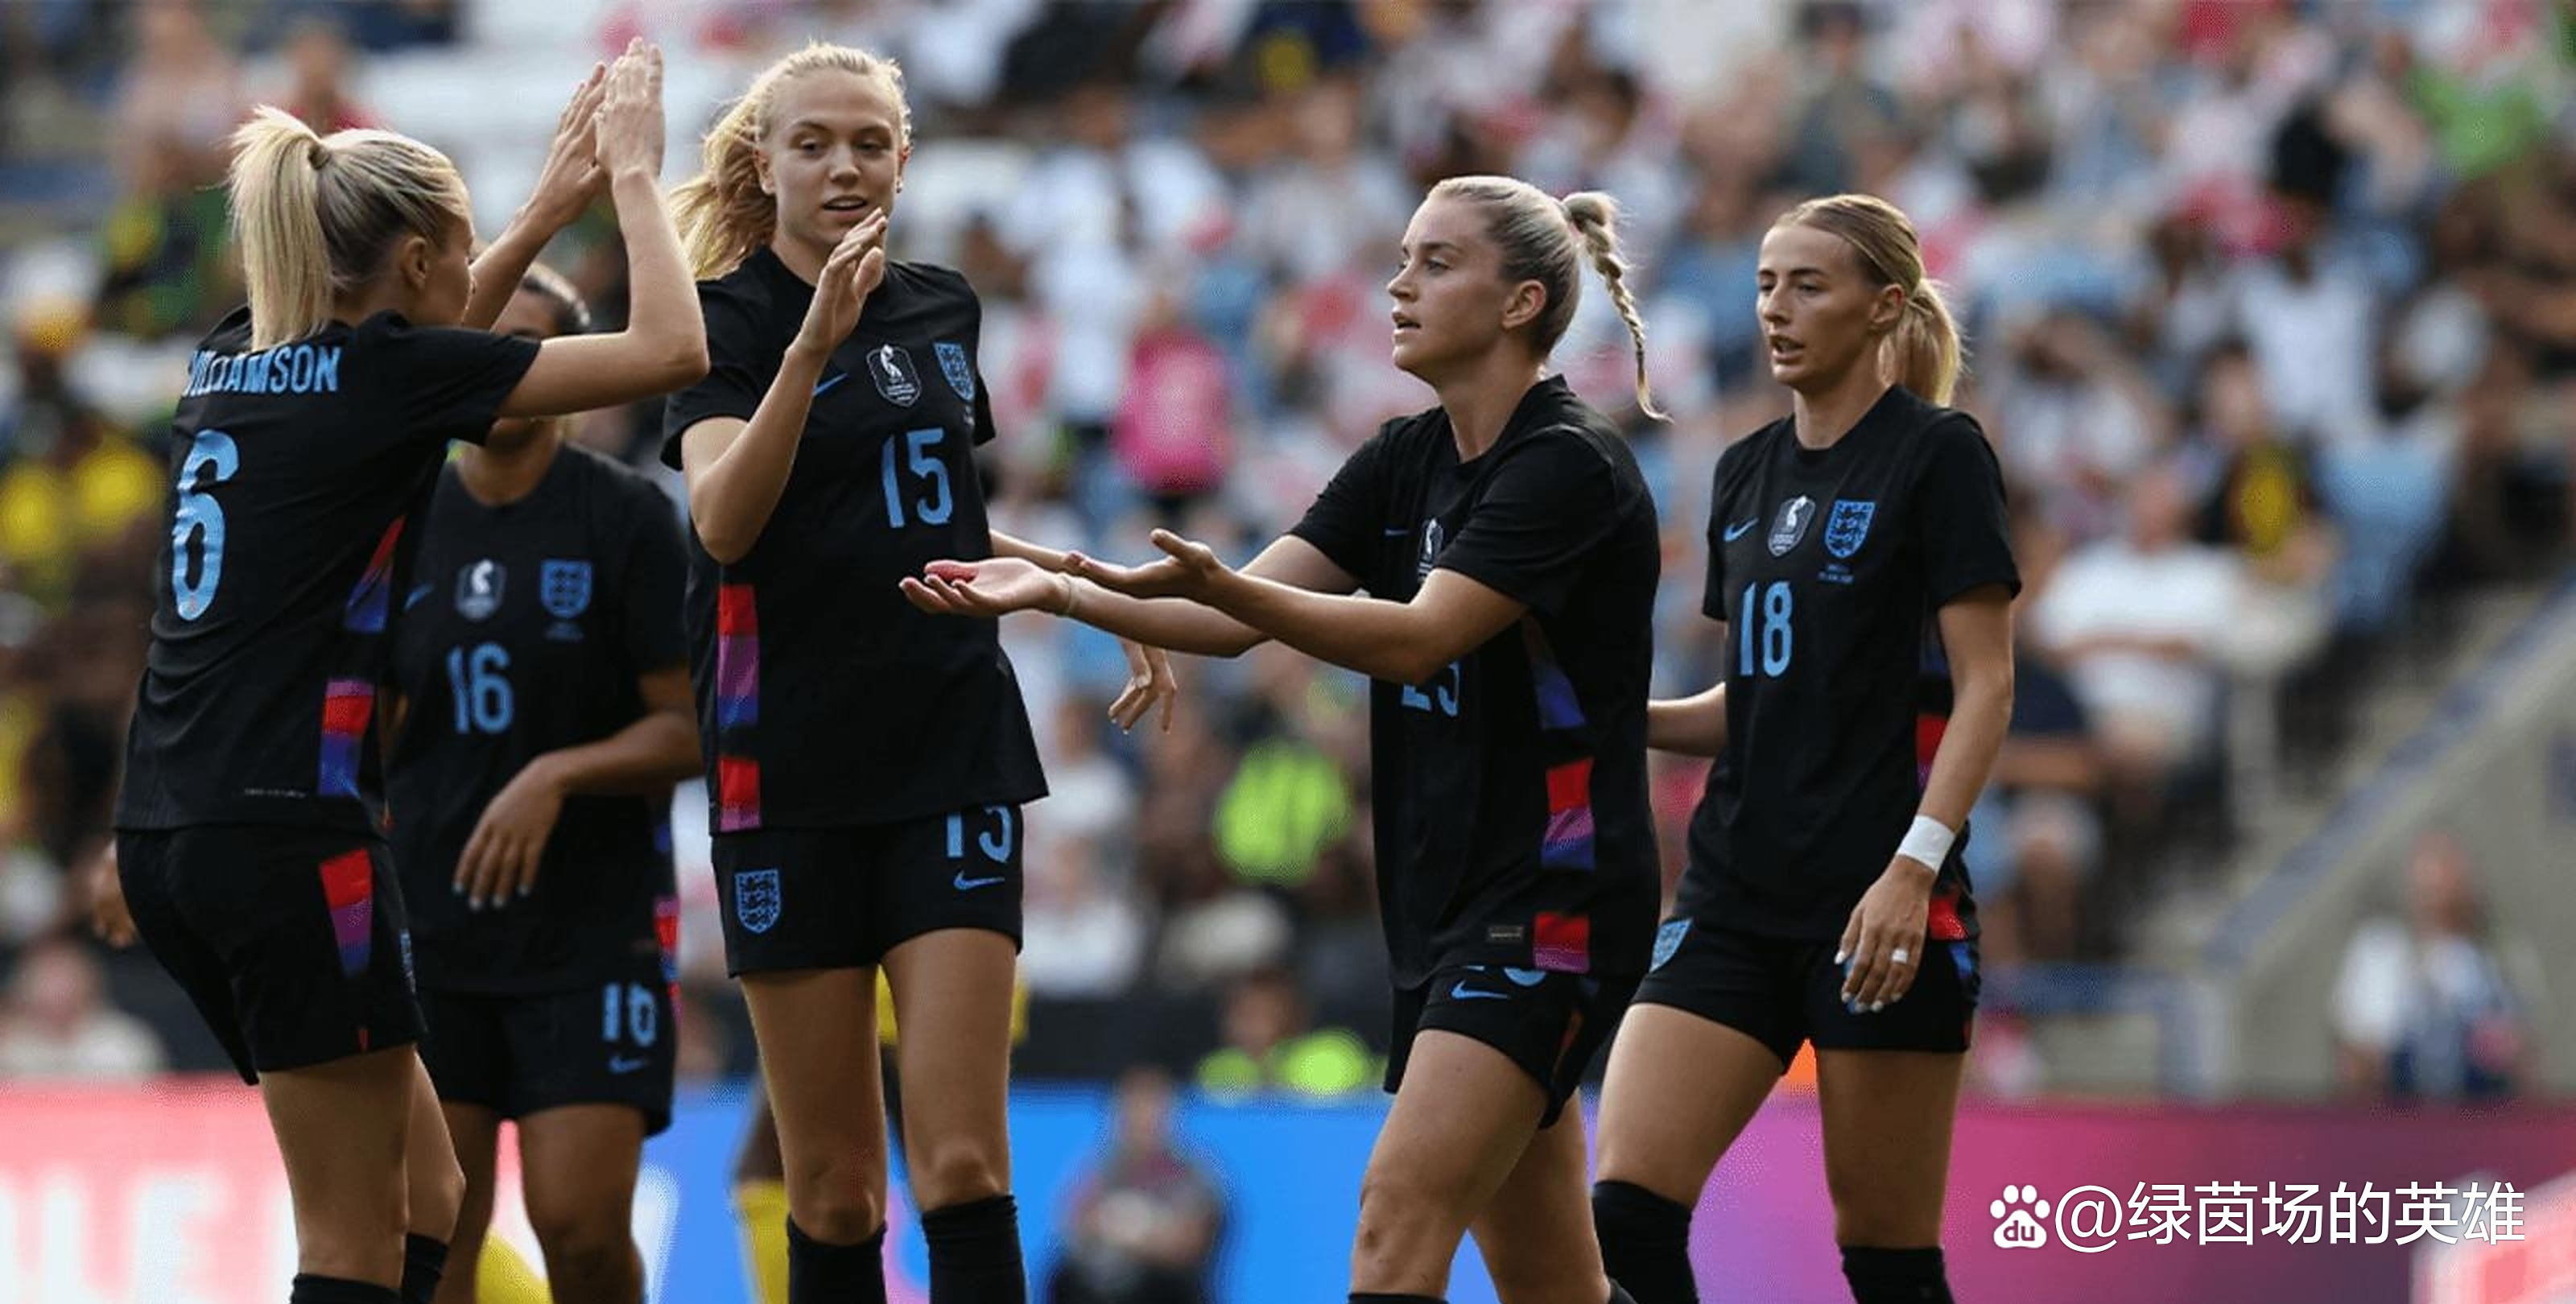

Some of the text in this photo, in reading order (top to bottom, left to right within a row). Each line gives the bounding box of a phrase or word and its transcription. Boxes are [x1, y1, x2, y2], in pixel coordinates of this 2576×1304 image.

[171, 428, 240, 621] 6
[881, 427, 954, 529] 15
[1739, 580, 1794, 679] 18
[448, 642, 513, 732] 16
[603, 982, 656, 1046] 16
